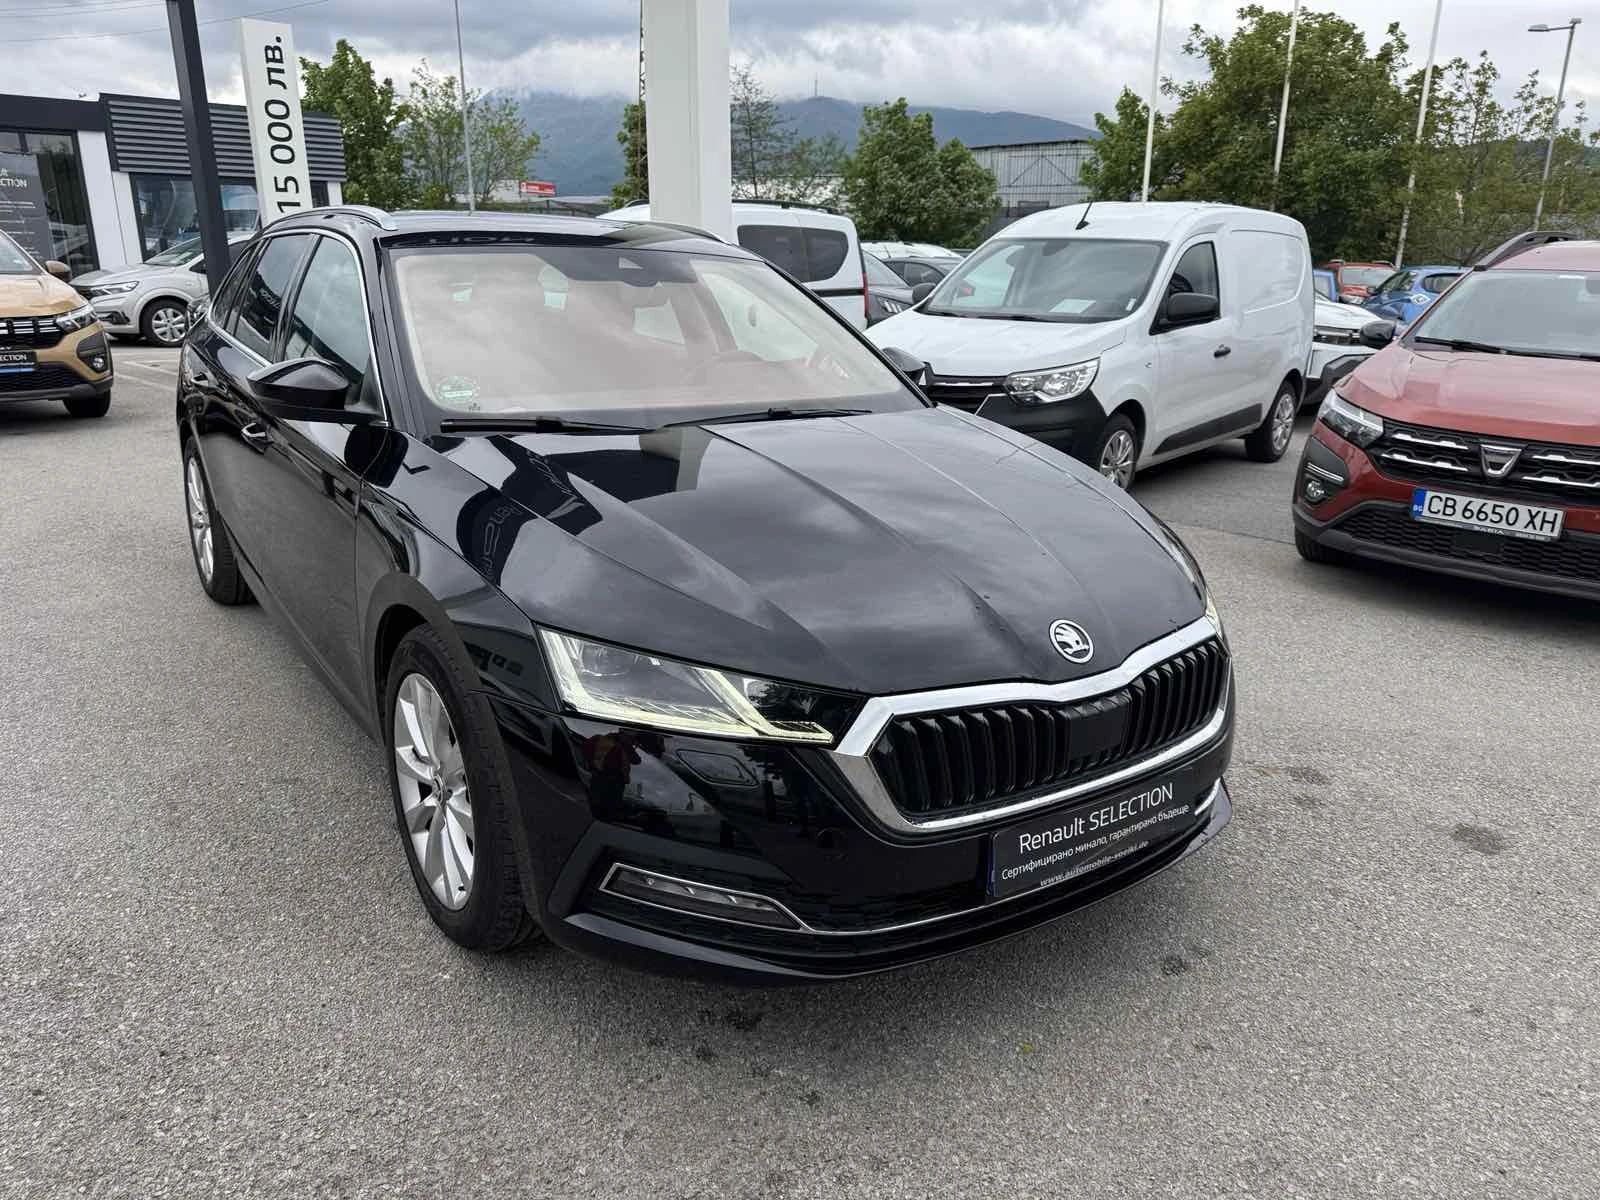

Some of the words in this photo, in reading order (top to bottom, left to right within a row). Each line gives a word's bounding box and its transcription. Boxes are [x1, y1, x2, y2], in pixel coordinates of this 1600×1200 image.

[264, 35, 288, 90] лв.
[264, 99, 296, 165] 000
[273, 175, 301, 214] 15
[1427, 495, 1457, 517] CB
[1462, 500, 1520, 527] 6650
[1524, 508, 1558, 533] XH
[1001, 848, 1074, 880] Сертифицирано
[1075, 836, 1108, 855] минало,
[1109, 815, 1158, 841] гарантирано
[1157, 804, 1190, 822] бъдеще
[1019, 817, 1086, 855] Renault
[1088, 782, 1174, 831] SELECTION
